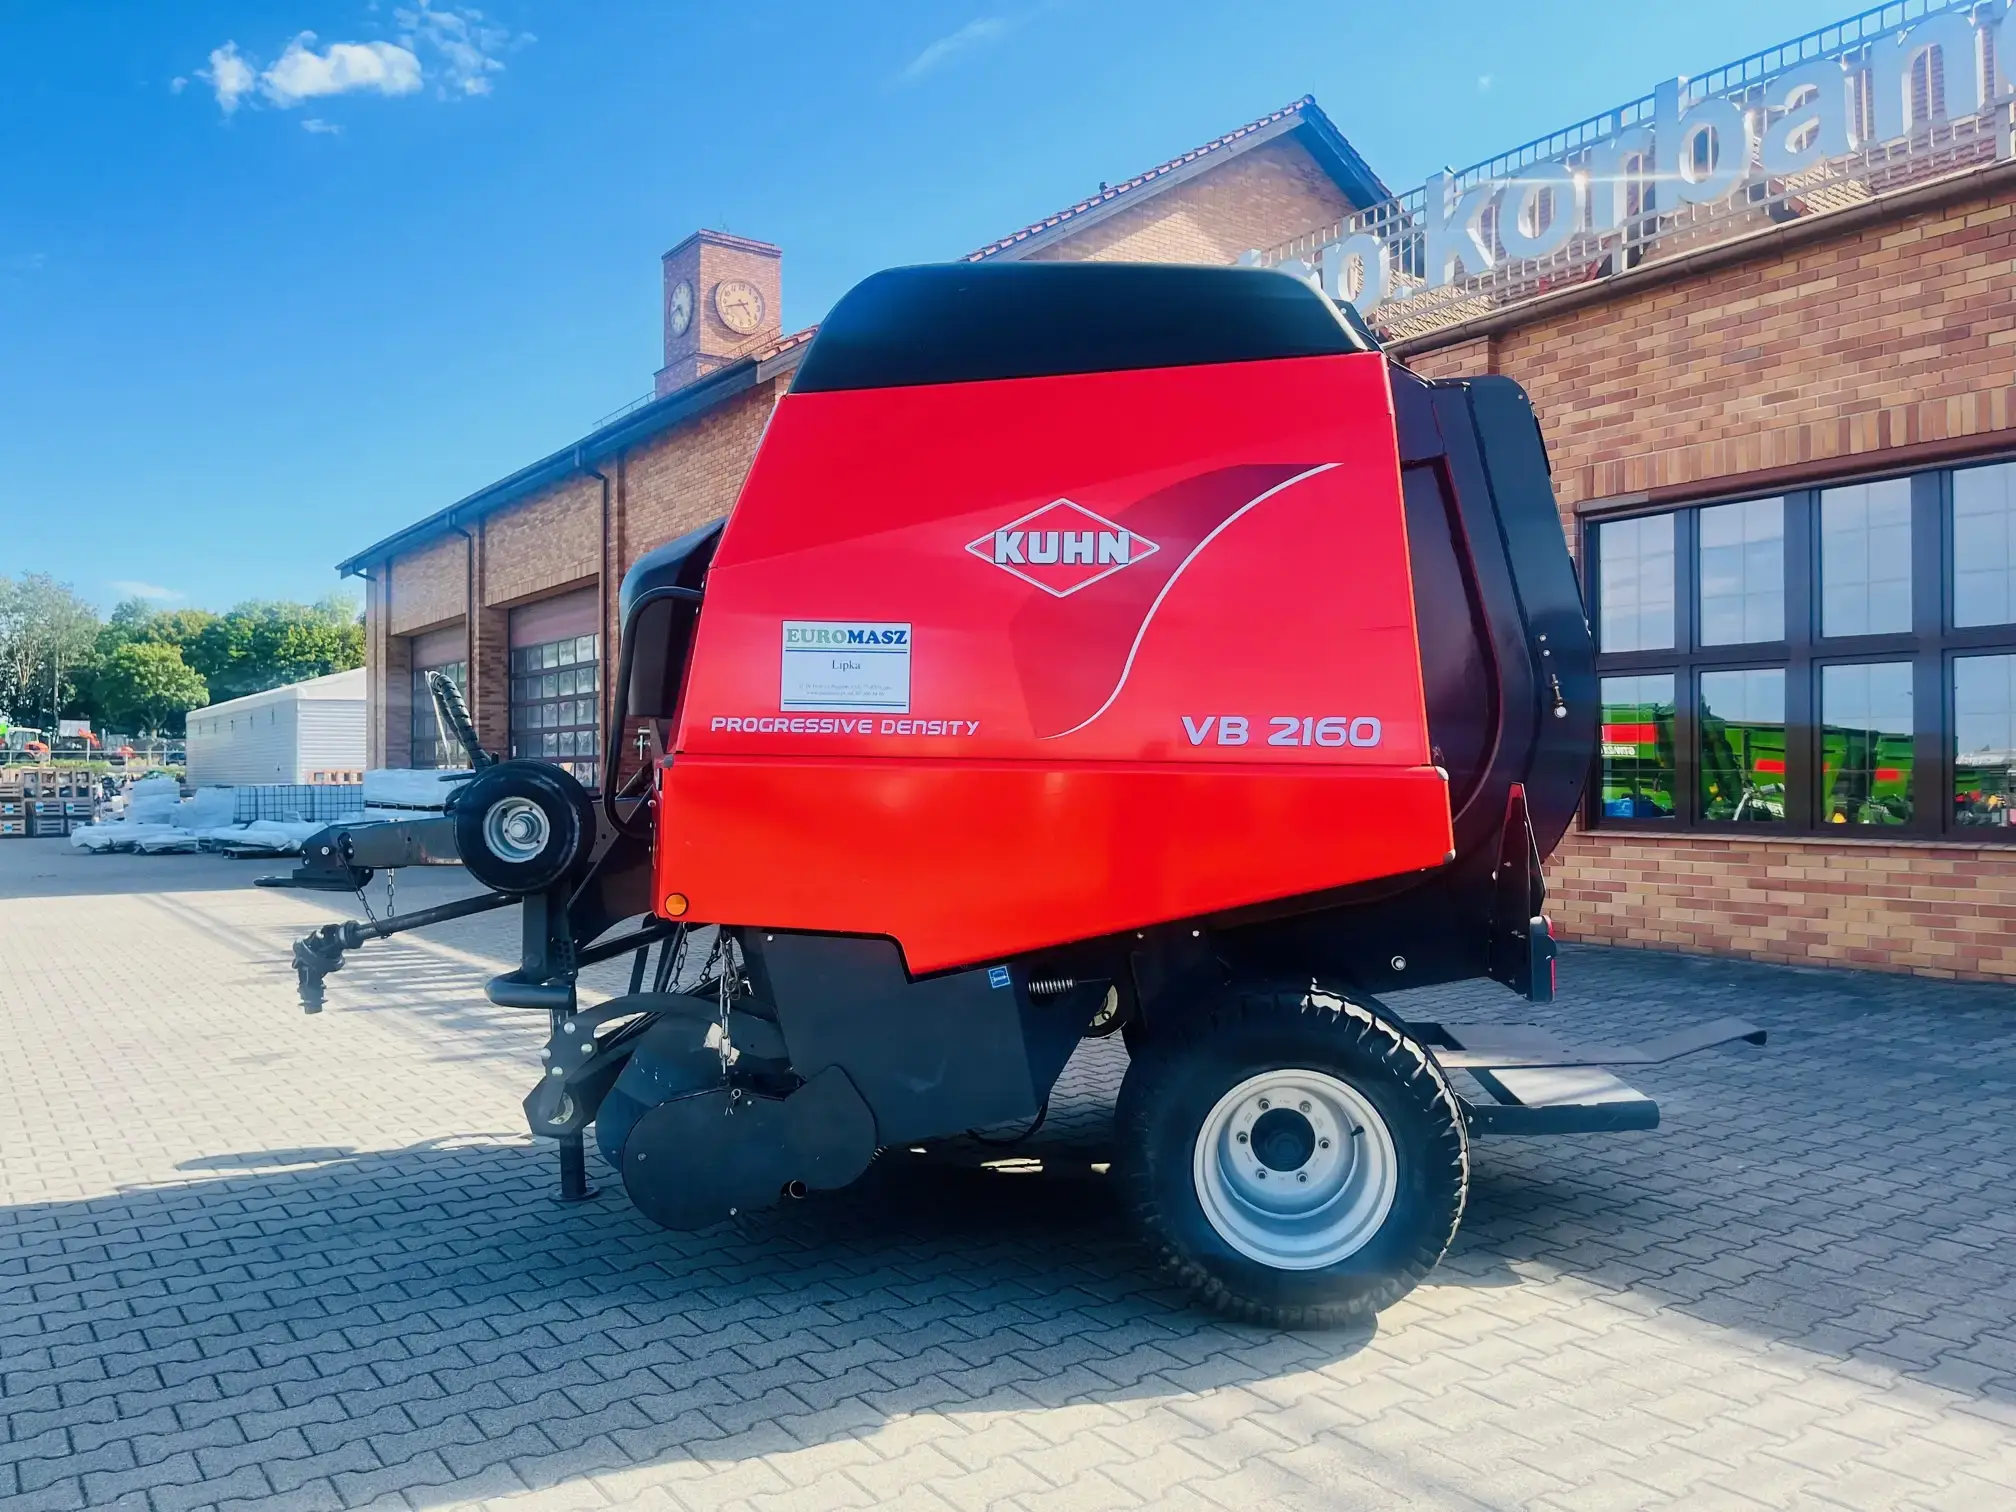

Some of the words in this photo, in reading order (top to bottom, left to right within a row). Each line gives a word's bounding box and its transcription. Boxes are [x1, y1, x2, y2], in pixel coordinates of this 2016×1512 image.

[1424, 1, 2016, 286] korban
[994, 531, 1130, 564] KUHN
[786, 628, 908, 645] EUROMASZ
[831, 659, 862, 671] Lipka
[711, 717, 873, 734] PROGRESSIVE
[880, 719, 980, 736] DENSITY
[1181, 716, 1249, 746] VB
[1267, 716, 1382, 747] 2160
